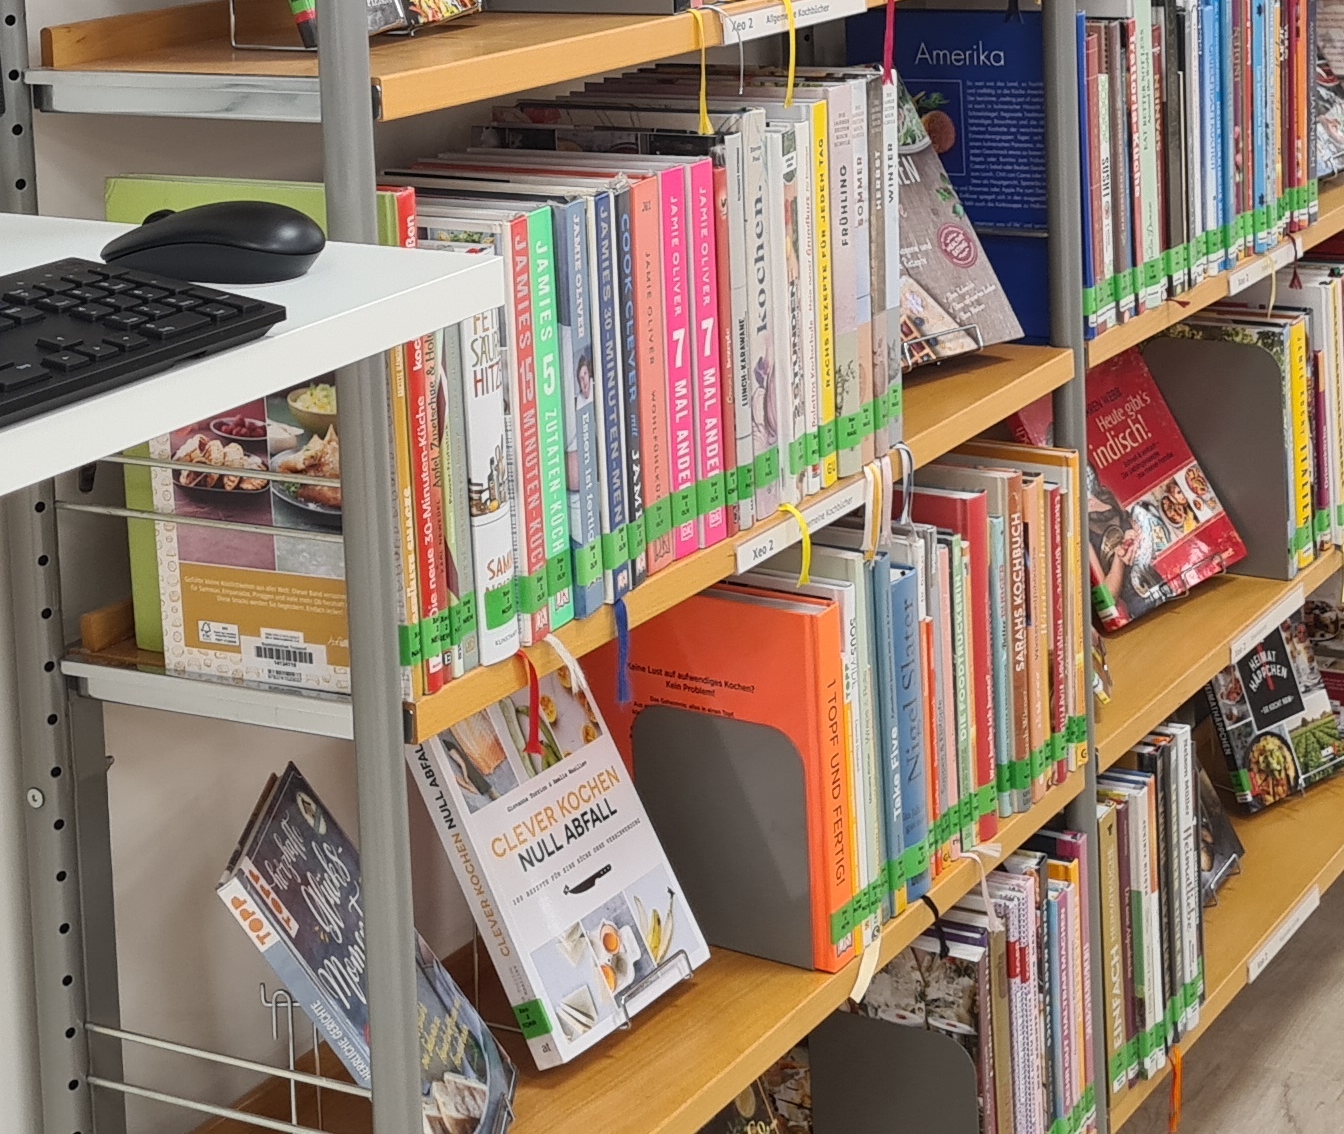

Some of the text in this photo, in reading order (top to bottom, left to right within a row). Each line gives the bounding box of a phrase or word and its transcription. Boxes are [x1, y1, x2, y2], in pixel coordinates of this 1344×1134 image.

[731, 17, 754, 33] Xeo 2
[798, 2, 830, 17] Kochbücher
[914, 41, 1006, 67] Amerika
[1233, 25, 1242, 83] INDIEN
[1128, 31, 1142, 199] Trattoria-Küche
[1308, 91, 1317, 168] JAPANISCH
[837, 164, 849, 247] FRÜHLING
[855, 156, 865, 226] SOMMER
[872, 150, 883, 210] HERBST
[886, 142, 894, 204] WINTER
[1101, 156, 1111, 198] SUSHI
[513, 234, 532, 349] JAMIES
[573, 213, 588, 339] JAMIE OLIVER
[644, 250, 653, 297] JAMIE
[698, 185, 718, 410] JAMIE OLIVER 7 MAL
[750, 184, 769, 337] kochen.
[816, 138, 832, 388] RACHS REZEPTE FÜR JEDEN TAG
[620, 213, 640, 437] COOK CLEVER mit
[646, 304, 656, 366] OLIVER
[669, 195, 690, 422] JAMIE OLIVER 7 MAL
[425, 366, 435, 378] &
[519, 360, 535, 404] 15
[536, 239, 567, 554] JAMIES 5 ZUTATEN-KÜCH
[598, 205, 625, 525] JAMIES 30-MINUTEN-MEN
[737, 316, 749, 408] LUNCH-KARAWANE
[1088, 413, 1153, 470] indisch!
[1095, 389, 1152, 433] Heute gibt's
[581, 411, 594, 490] Essen ist
[1299, 444, 1311, 527] ITALIEN
[414, 395, 437, 590] neue 30-Minuten-Küche
[825, 496, 854, 517] Kochbücher
[752, 539, 774, 561] Xeo 2
[1010, 512, 1025, 672] SARAHS KOCHBUCH
[647, 665, 755, 694] Lust auf aufwendiges Kochen?
[665, 680, 716, 697] Kein Problem!
[900, 598, 922, 787] Nigel Slater
[954, 575, 969, 742] DIE FOODTRUCKERIN
[1248, 649, 1277, 671] HEIMAT
[1248, 663, 1288, 692] HÄPPCHEN
[413, 743, 440, 788] ABFAL
[826, 678, 847, 888] 1 TOPF UND FERTIG!
[888, 726, 902, 822] Take Five
[490, 765, 621, 859] CLEVER KOCHEN
[506, 796, 529, 812] Giovanna
[517, 797, 618, 873] NULL ABFALL
[248, 869, 294, 932] TOPP
[433, 789, 511, 957] CLEVER KOCHEN NULL
[525, 842, 606, 898] REZEPTE FÜR EINE KÜCHE OHNE
[230, 894, 272, 947] TOPP
[1109, 945, 1124, 1048] EINFACH
[309, 999, 372, 1083] HERRLICHE GERICHTE
